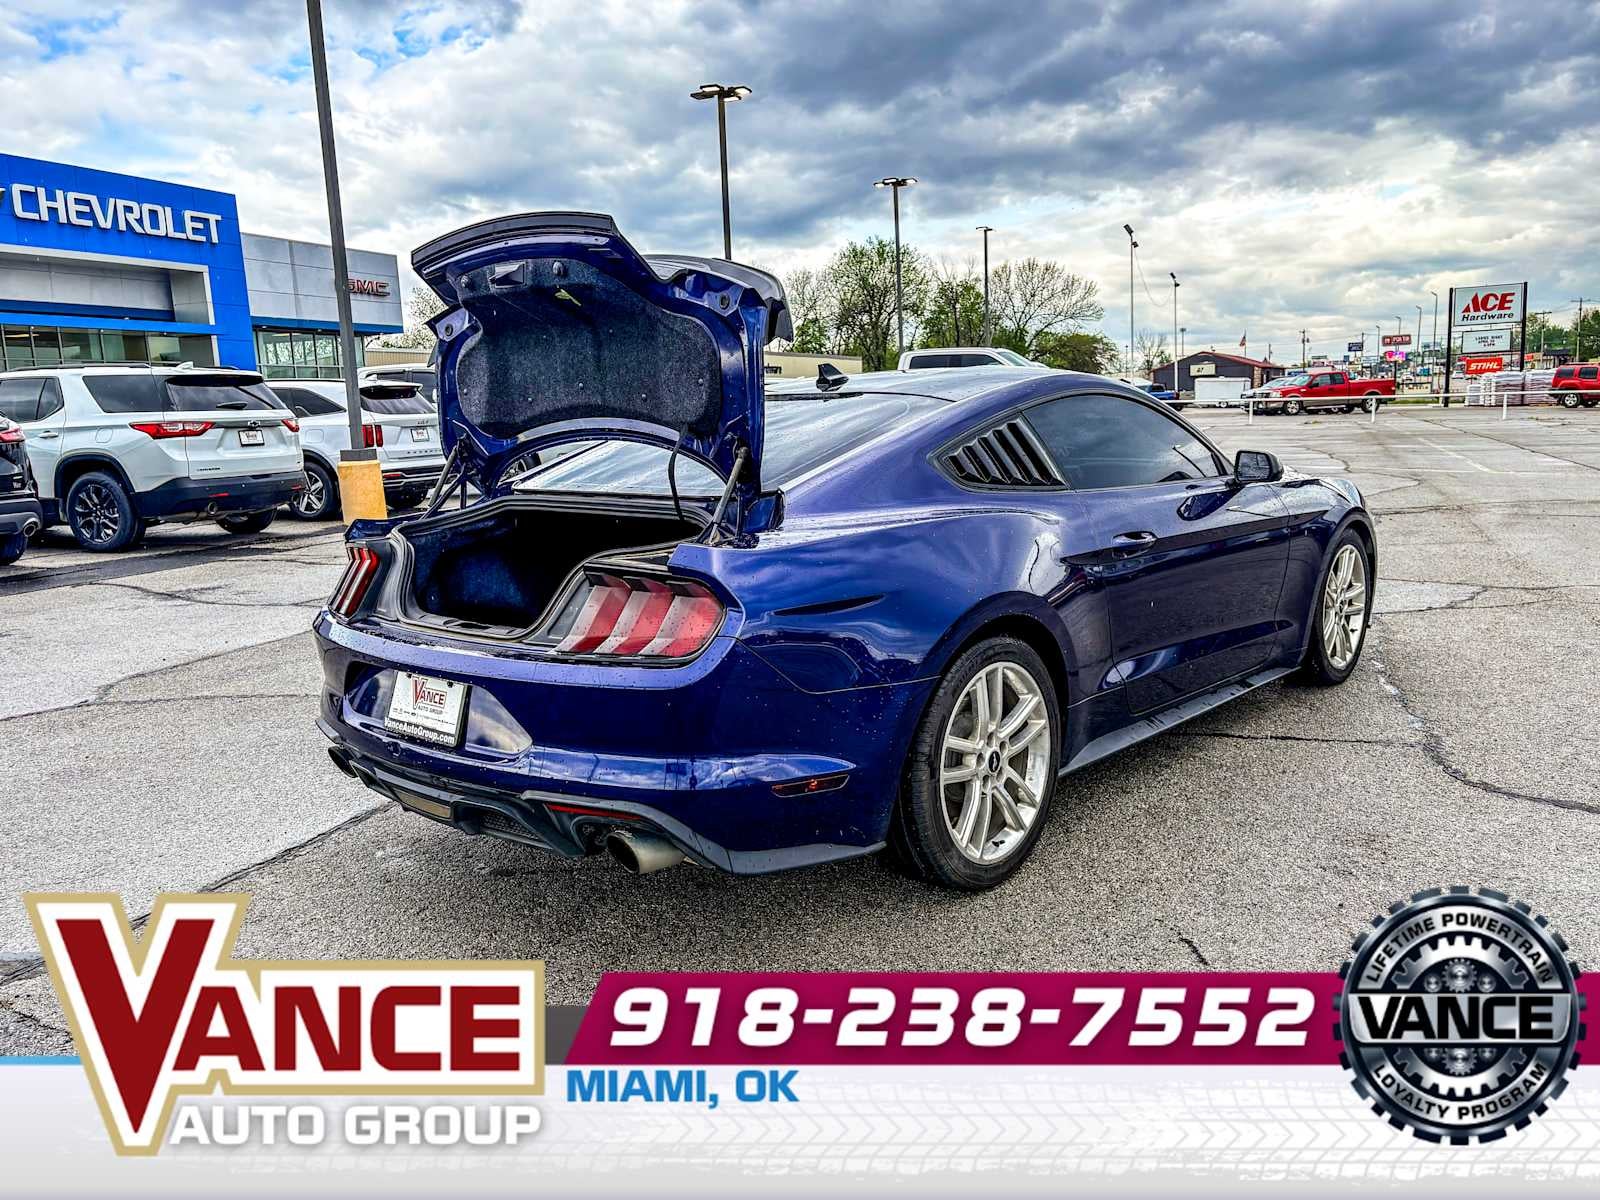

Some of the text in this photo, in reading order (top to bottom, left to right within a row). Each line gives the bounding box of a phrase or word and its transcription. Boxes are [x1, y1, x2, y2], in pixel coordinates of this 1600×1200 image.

[11, 183, 222, 244] CHEVROLET
[1461, 292, 1516, 313] ACE
[1461, 312, 1515, 322] Hardware
[1468, 361, 1501, 371] STIHL
[384, 716, 455, 745] VanceAutoGroup.com
